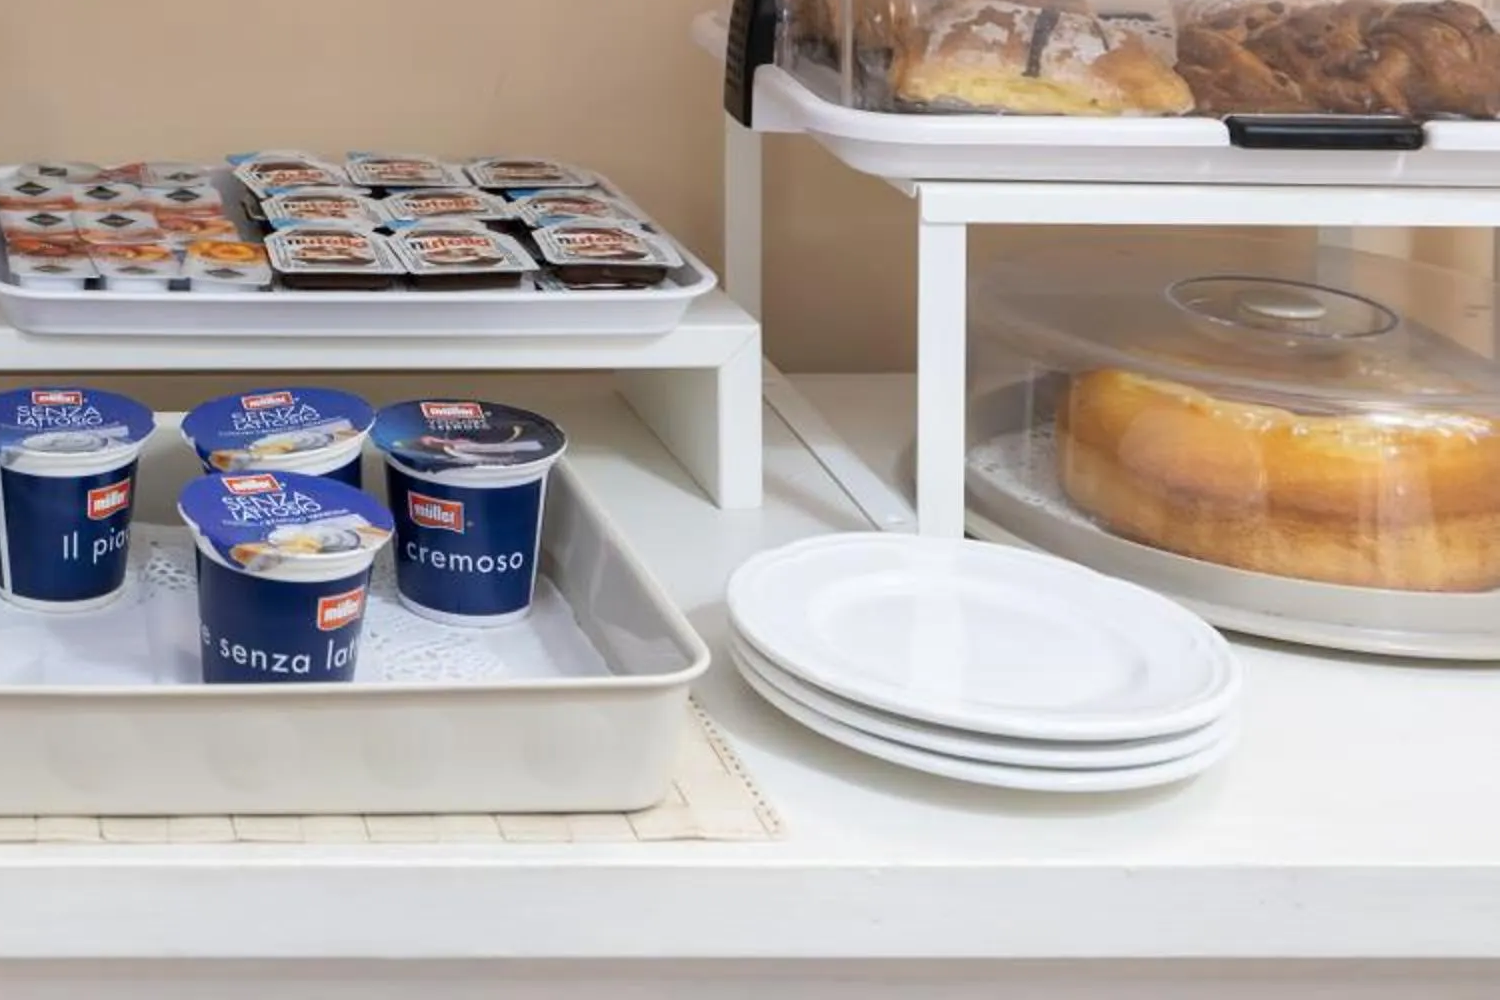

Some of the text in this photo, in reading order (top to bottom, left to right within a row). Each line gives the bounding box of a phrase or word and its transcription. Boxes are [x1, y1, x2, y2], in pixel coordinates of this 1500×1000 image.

[409, 236, 491, 250] nutella
[17, 405, 99, 417] SENZA
[222, 491, 318, 510] SENZA
[414, 501, 456, 526] müller
[63, 530, 79, 561] Il
[407, 541, 524, 574] cremoso
[219, 637, 312, 675] senza
